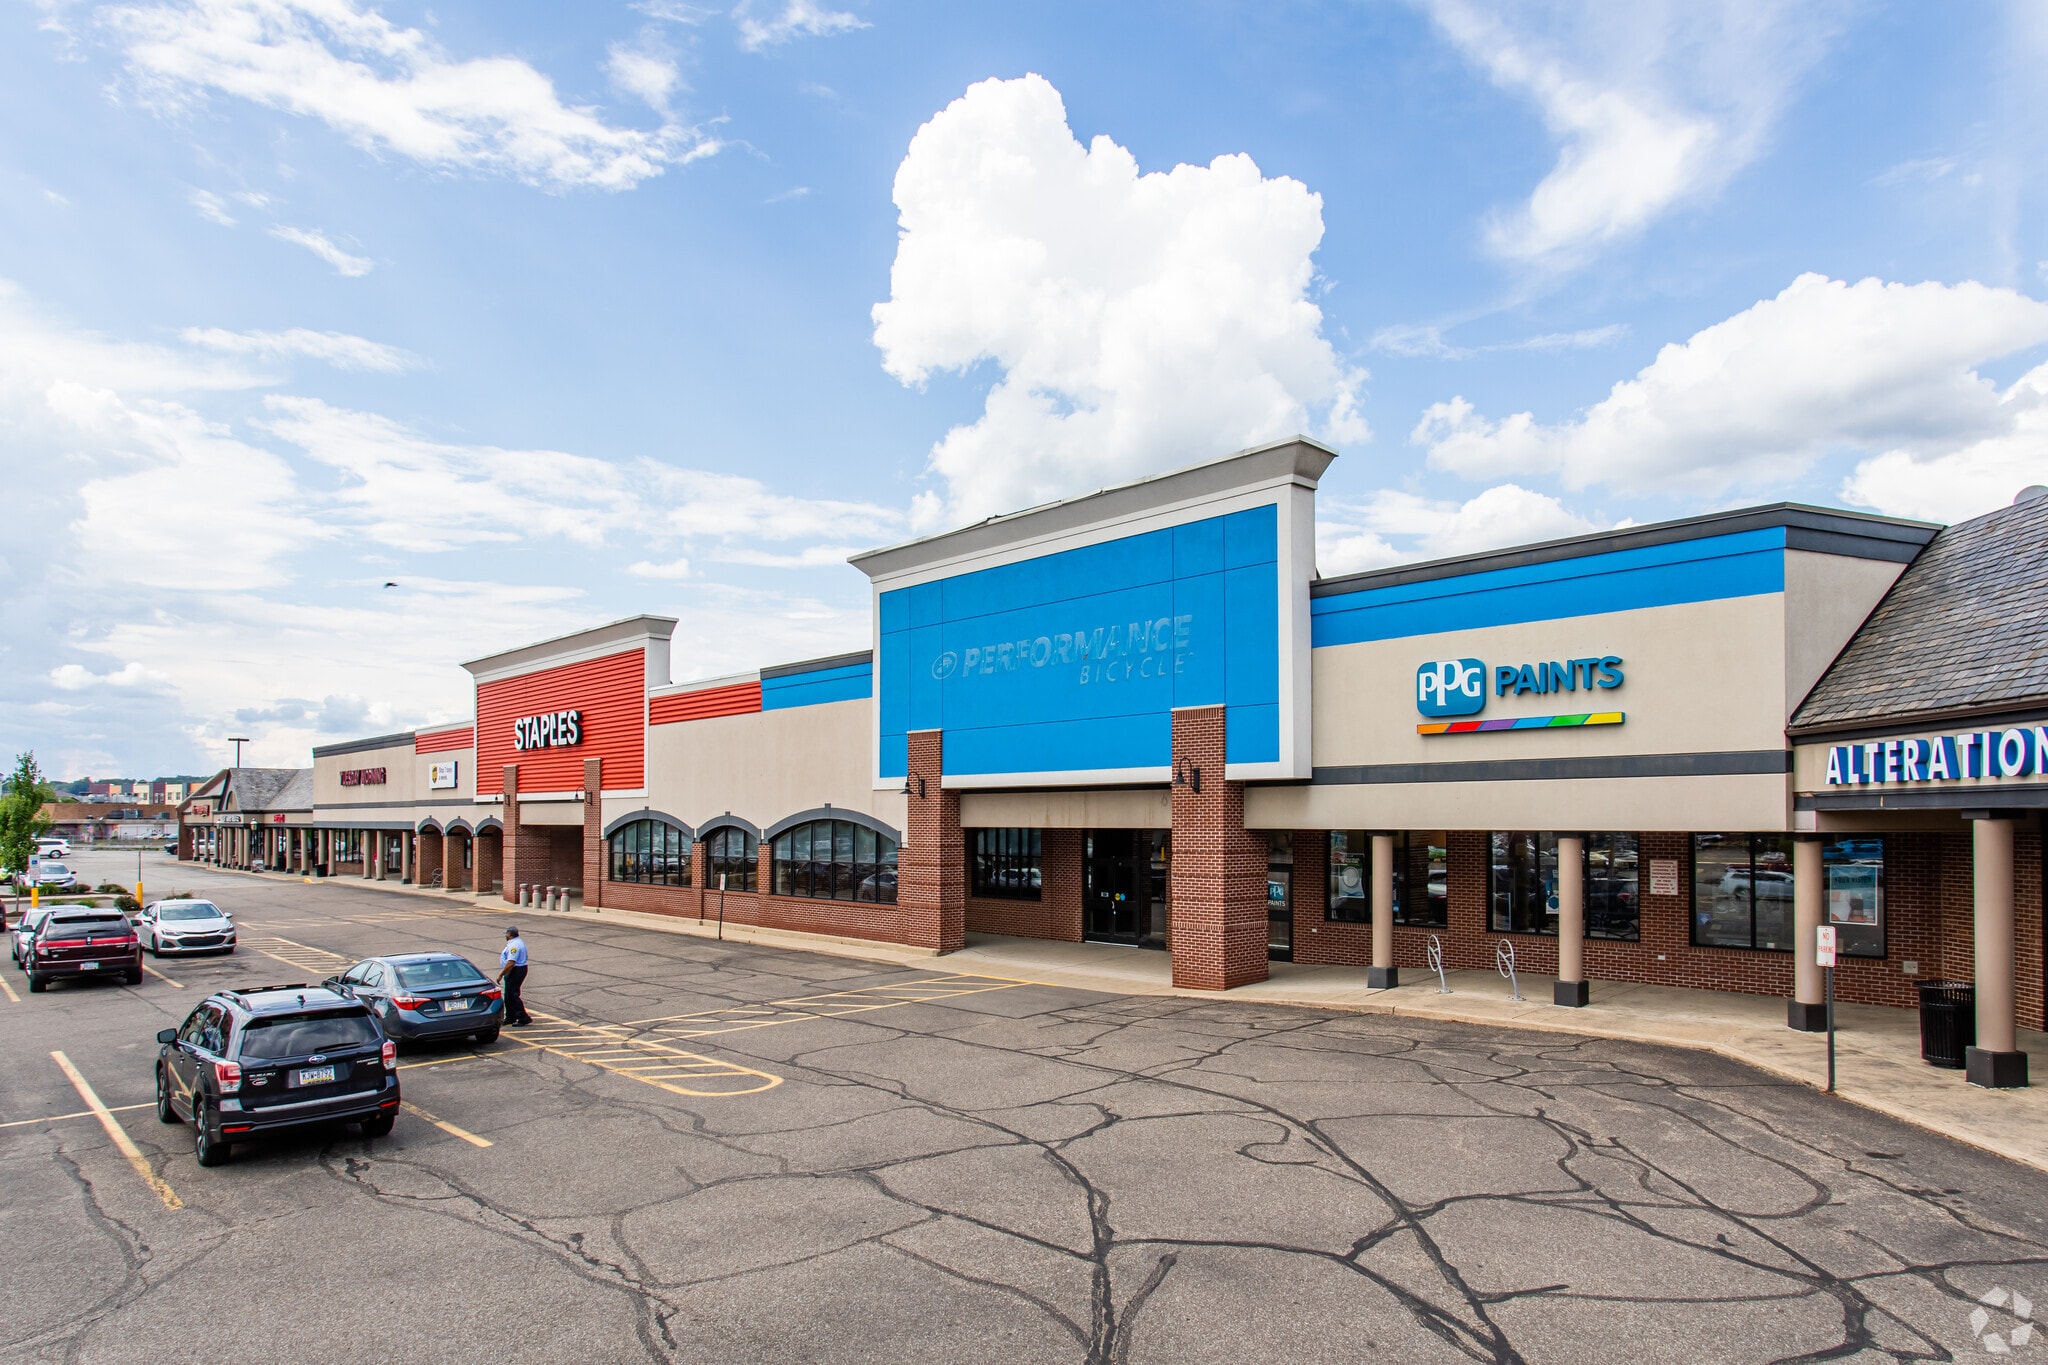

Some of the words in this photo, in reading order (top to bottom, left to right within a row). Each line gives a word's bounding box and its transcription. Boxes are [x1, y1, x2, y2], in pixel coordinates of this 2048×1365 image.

[962, 614, 1193, 678] PERFORMANCE
[1080, 652, 1187, 685] BICYCLE
[1419, 659, 1481, 707] PPG
[1495, 655, 1625, 697] PAINTS
[514, 709, 581, 751] STAPLES
[1822, 932, 1830, 941] NO
